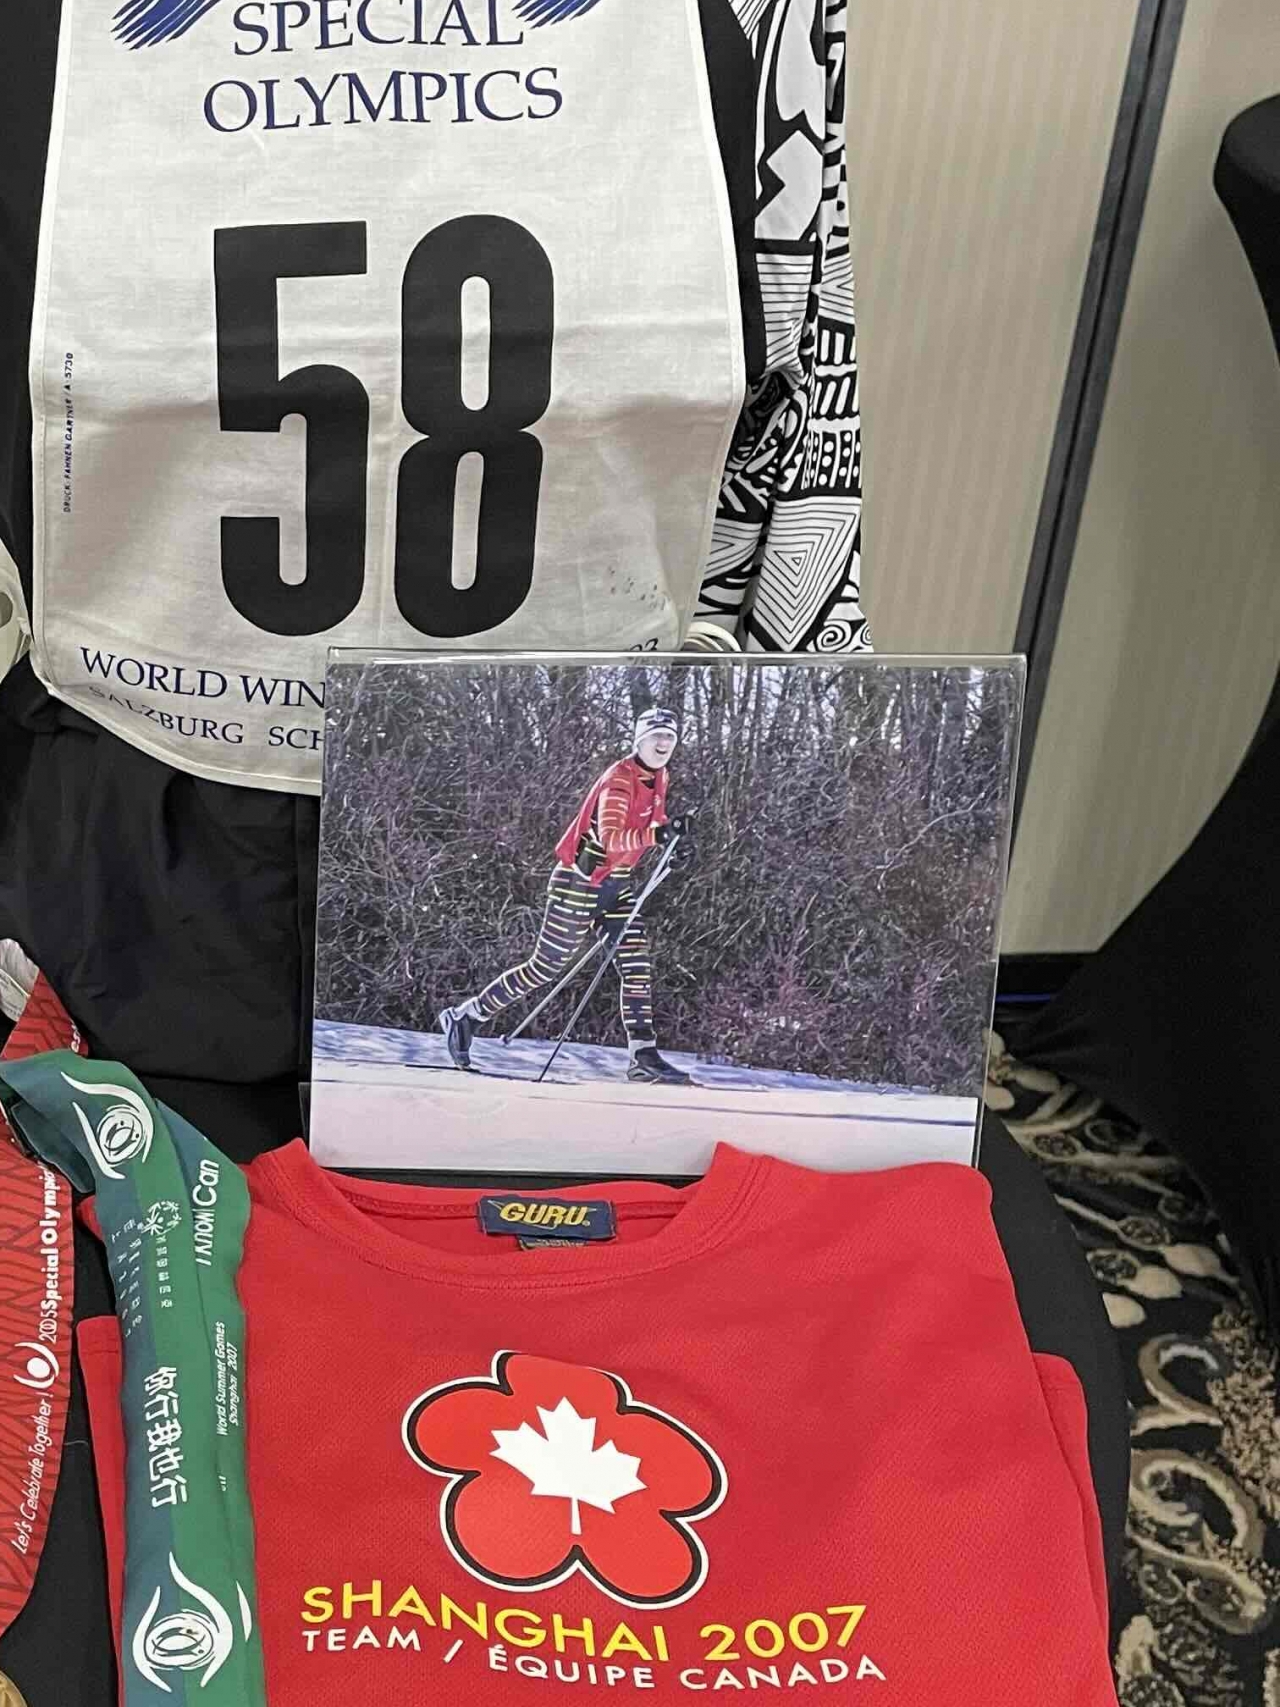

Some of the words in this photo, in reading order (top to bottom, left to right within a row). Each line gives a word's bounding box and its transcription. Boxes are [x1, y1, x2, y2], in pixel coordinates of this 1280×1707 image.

[233, 0, 524, 56] SPECIAL
[203, 67, 563, 133] OLYMPICS
[213, 214, 555, 639] 58
[80, 646, 228, 698] WORLD
[89, 685, 244, 744] SALZBURG
[192, 1159, 220, 1207] Can
[40, 1248, 63, 1312] Special
[214, 1321, 225, 1361] Games
[226, 1341, 238, 1371] 2007
[215, 1363, 227, 1407] Summer
[216, 1407, 229, 1436] World
[18, 1456, 45, 1521] Celebrate
[11, 1516, 37, 1554] Let's
[301, 1579, 669, 1662] SHANGHAI
[700, 1605, 867, 1662] 2007
[301, 1627, 421, 1652] TEAM
[443, 1638, 464, 1664] /
[489, 1645, 656, 1689] ÉQUIPE
[680, 1655, 886, 1691] CANADA
